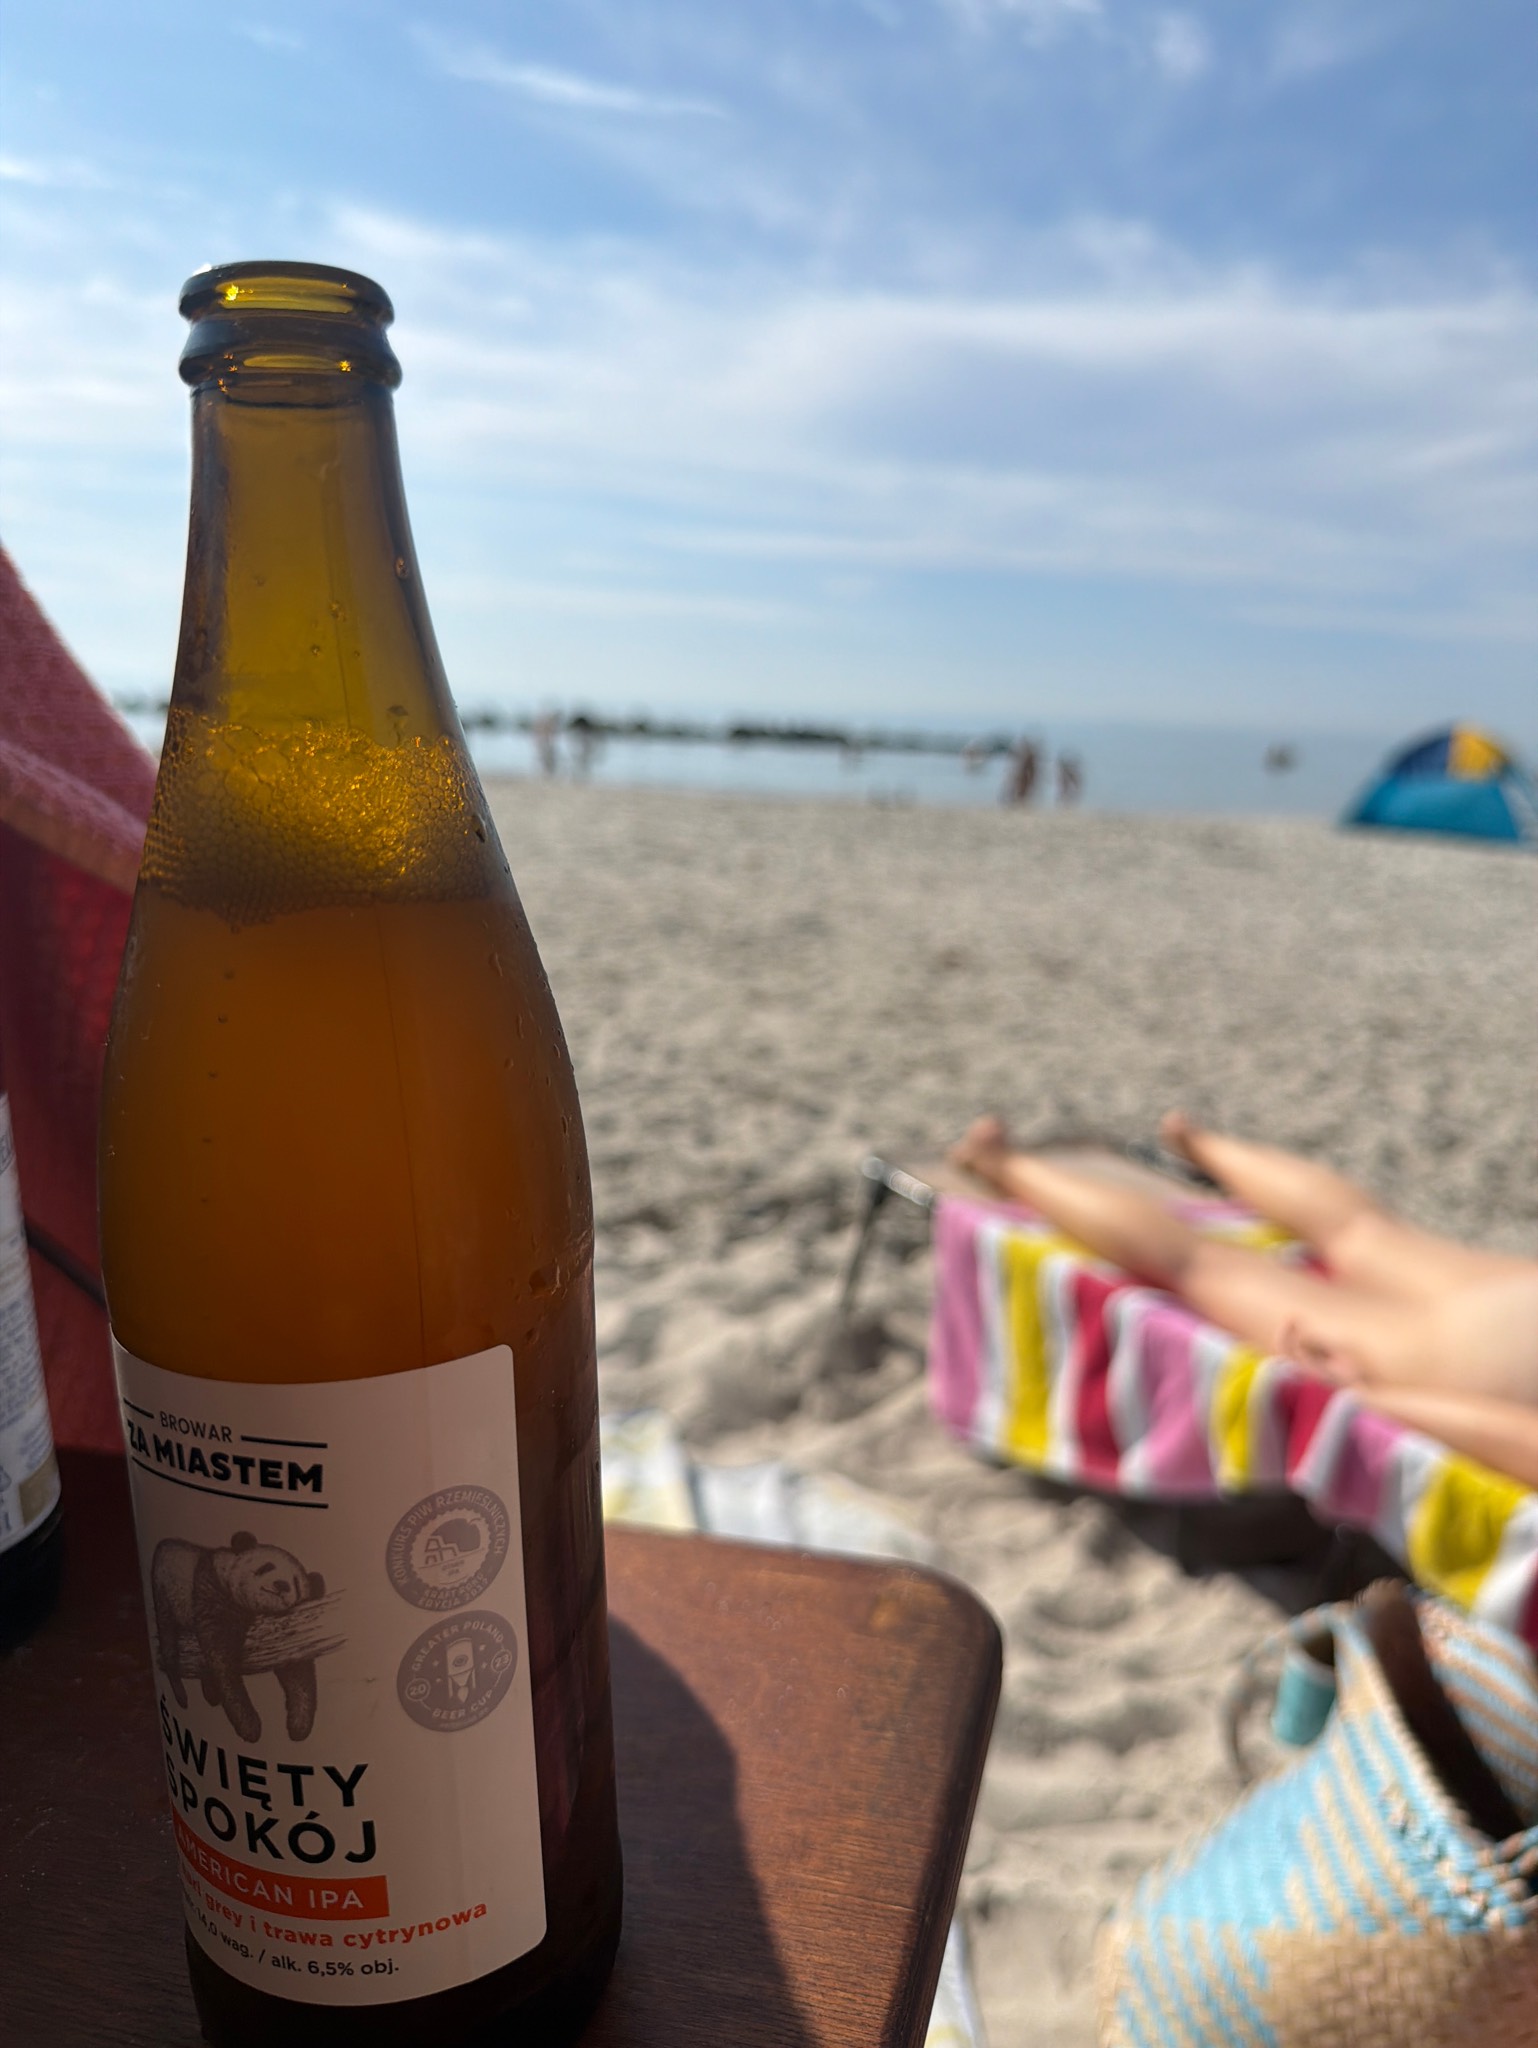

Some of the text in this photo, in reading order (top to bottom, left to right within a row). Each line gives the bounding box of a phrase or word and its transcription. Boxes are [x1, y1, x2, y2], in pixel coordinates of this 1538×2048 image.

[159, 1410, 233, 1443] BROWAR
[127, 1419, 323, 1493] ZA MIASTEM
[391, 1527, 412, 1584] KONKURS
[409, 1503, 433, 1526] PIW
[412, 1620, 505, 1672] GREATER POLAND
[409, 1683, 427, 1697] 20
[432, 1707, 466, 1720] BEER
[470, 1688, 493, 1712] CUP
[160, 1693, 369, 1812] ŚWIĘTY
[166, 1753, 377, 1864] SPOKÓJ
[177, 1824, 294, 1906] AMERICAN
[308, 1888, 365, 1910] IPA
[205, 1892, 243, 1928] grey
[250, 1915, 257, 1932] i
[263, 1921, 334, 1947] trawa
[343, 1902, 488, 1950] cytrynowa
[220, 1932, 254, 1958] wag.
[271, 1955, 302, 1972] alk.
[307, 1960, 355, 1977] 6,5%
[361, 1958, 400, 1976] obj.
